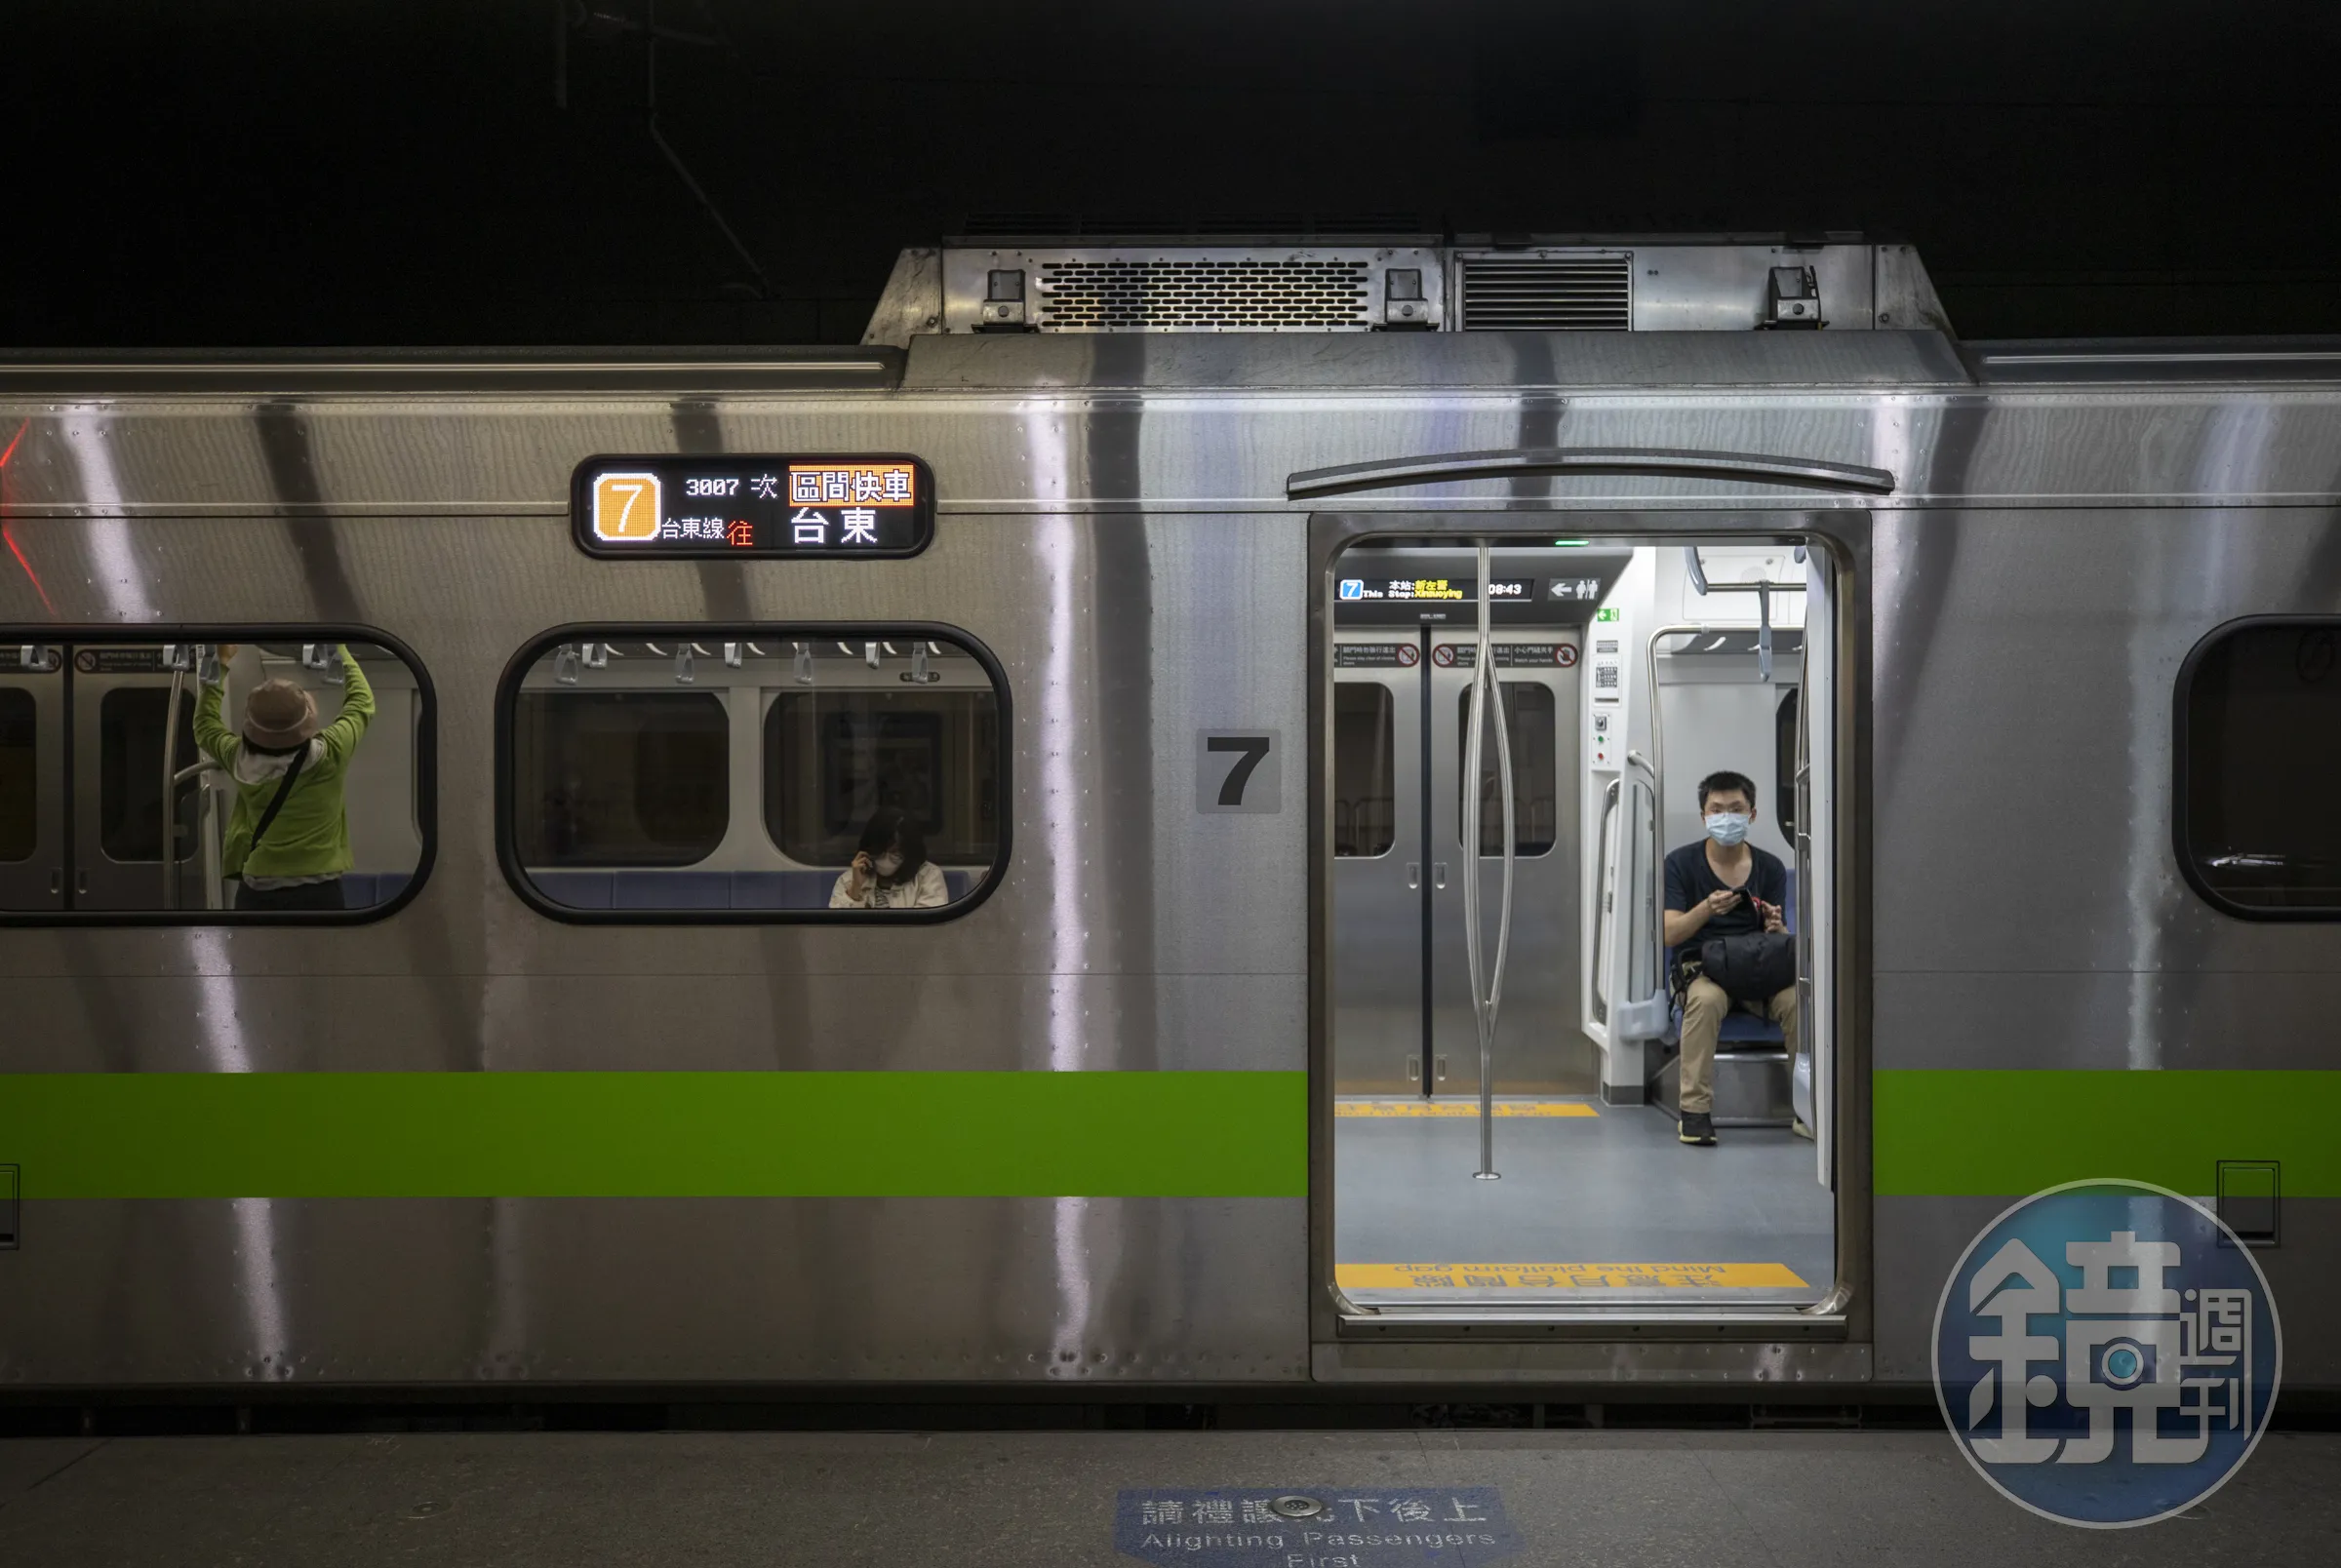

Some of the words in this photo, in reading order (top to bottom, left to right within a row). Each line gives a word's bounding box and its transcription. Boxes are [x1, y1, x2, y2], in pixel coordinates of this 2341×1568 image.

[686, 479, 739, 496] 3007
[750, 473, 779, 499] 次
[791, 469, 912, 502] 區間快車
[612, 484, 643, 533] 7
[790, 507, 878, 543] 台東
[1346, 582, 1359, 598] 7
[1364, 590, 1384, 599] This
[1488, 583, 1523, 596] 08:43
[1208, 736, 1270, 806] 7
[1140, 1496, 1488, 1525] 請禮讓下後上
[1140, 1532, 1284, 1550] Alighting
[1303, 1531, 1495, 1548] Passengers
[1287, 1553, 1359, 1568] First
